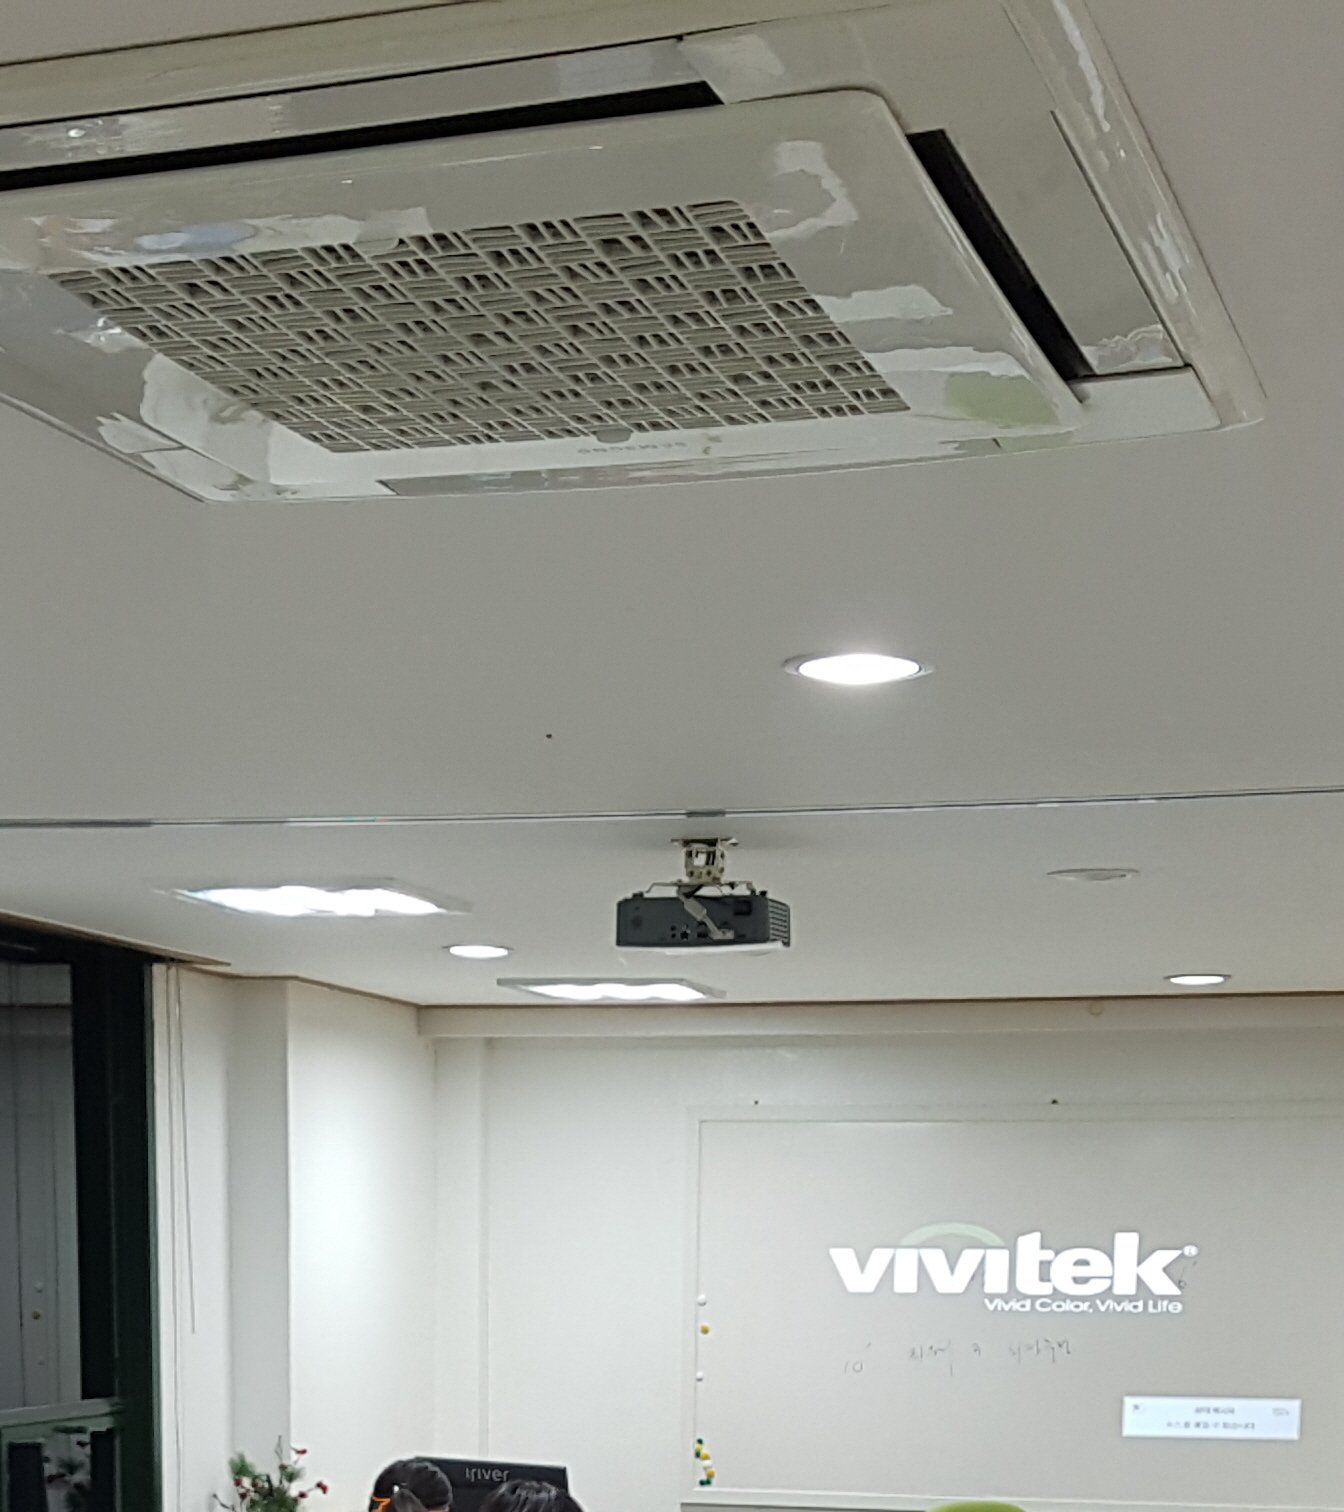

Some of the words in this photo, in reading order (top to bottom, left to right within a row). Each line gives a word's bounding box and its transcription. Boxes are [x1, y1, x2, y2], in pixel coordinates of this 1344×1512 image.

[828, 1230, 1184, 1297] vivitek
[983, 1298, 1031, 1313] Vivid
[1035, 1298, 1094, 1314] Color,
[1096, 1298, 1144, 1314] Vivid
[1148, 1299, 1183, 1314] Life
